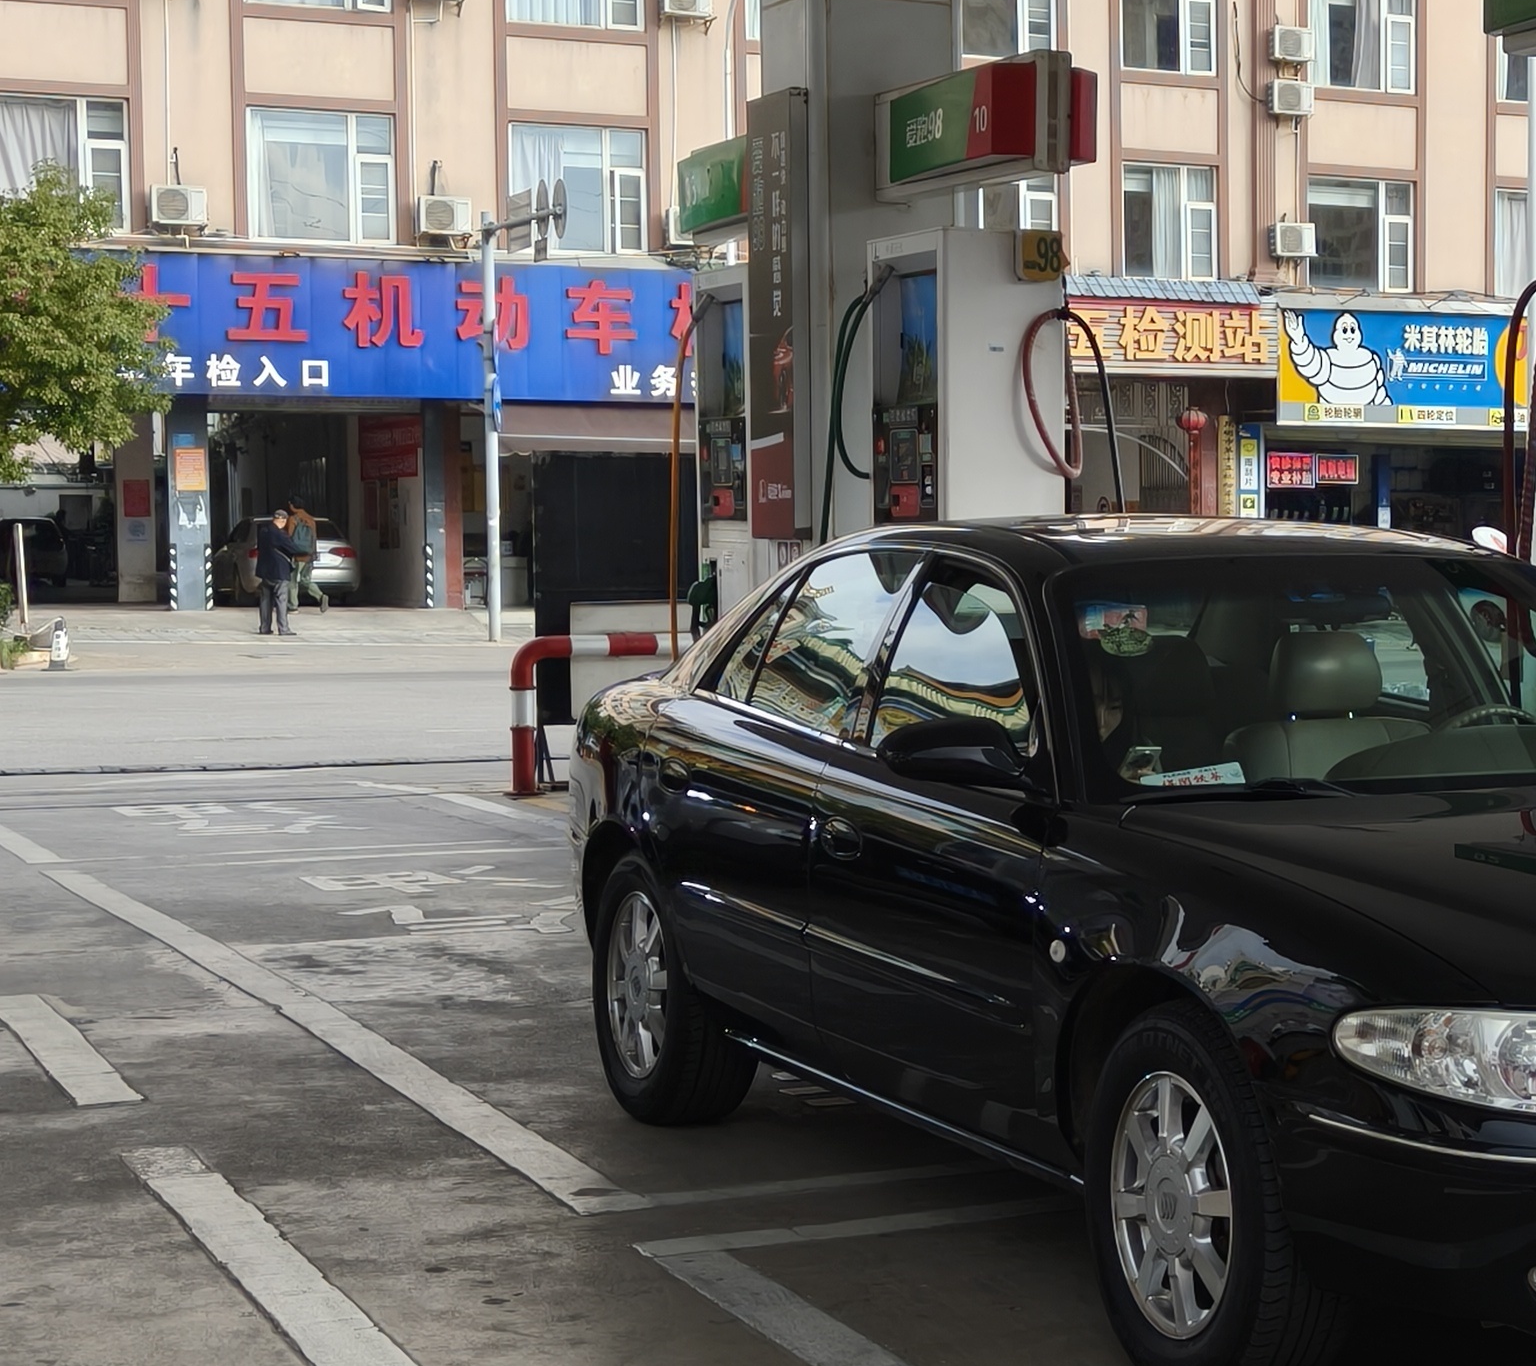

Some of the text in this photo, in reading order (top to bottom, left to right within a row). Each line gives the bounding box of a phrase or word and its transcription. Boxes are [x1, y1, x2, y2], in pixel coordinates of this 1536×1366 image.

[906, 105, 988, 148] 爱跑98 10
[771, 132, 782, 317] 不一样的感觉
[1036, 237, 1062, 272] 98
[1403, 324, 1488, 356] 米其林轮胎
[1407, 362, 1484, 375] MICHELIN
[1417, 409, 1454, 422] 四轮定位
